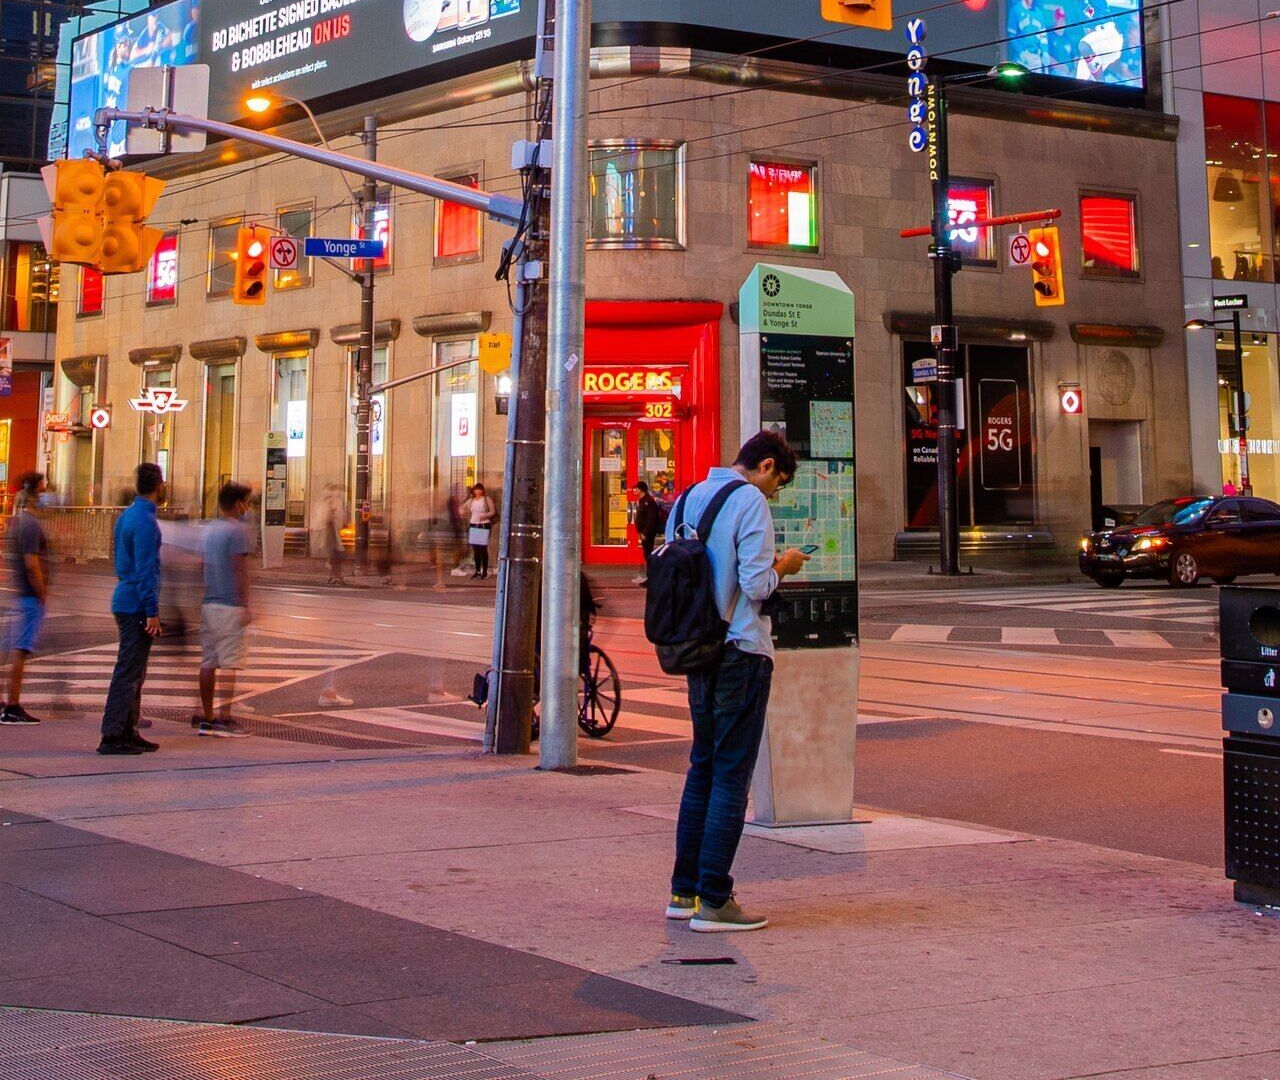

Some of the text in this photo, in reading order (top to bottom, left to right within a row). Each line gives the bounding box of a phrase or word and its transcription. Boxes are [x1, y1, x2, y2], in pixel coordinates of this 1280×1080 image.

[212, 29, 227, 52] BO
[228, 10, 278, 45] BICHETTE
[232, 14, 351, 72] & BOBBLEHEAD ON US
[457, 34, 475, 45] Galaxy
[251, 78, 260, 89] with
[260, 75, 272, 87] select
[273, 69, 295, 83] activations
[301, 64, 314, 75] select
[907, 18, 925, 152] Yonge
[928, 85, 938, 180] DOWNTOWN
[324, 240, 357, 257] Yonge
[1214, 298, 1226, 307] Foot
[1226, 298, 1244, 307] Locker
[763, 310, 787, 318] Dundas
[770, 320, 790, 328] Yonge
[584, 371, 672, 392] ROGERS
[646, 404, 672, 418] 302
[988, 417, 1012, 425] ROGERS
[987, 428, 1012, 451] 5G
[921, 446, 939, 454] Canad
[1261, 647, 1278, 657] Litter
